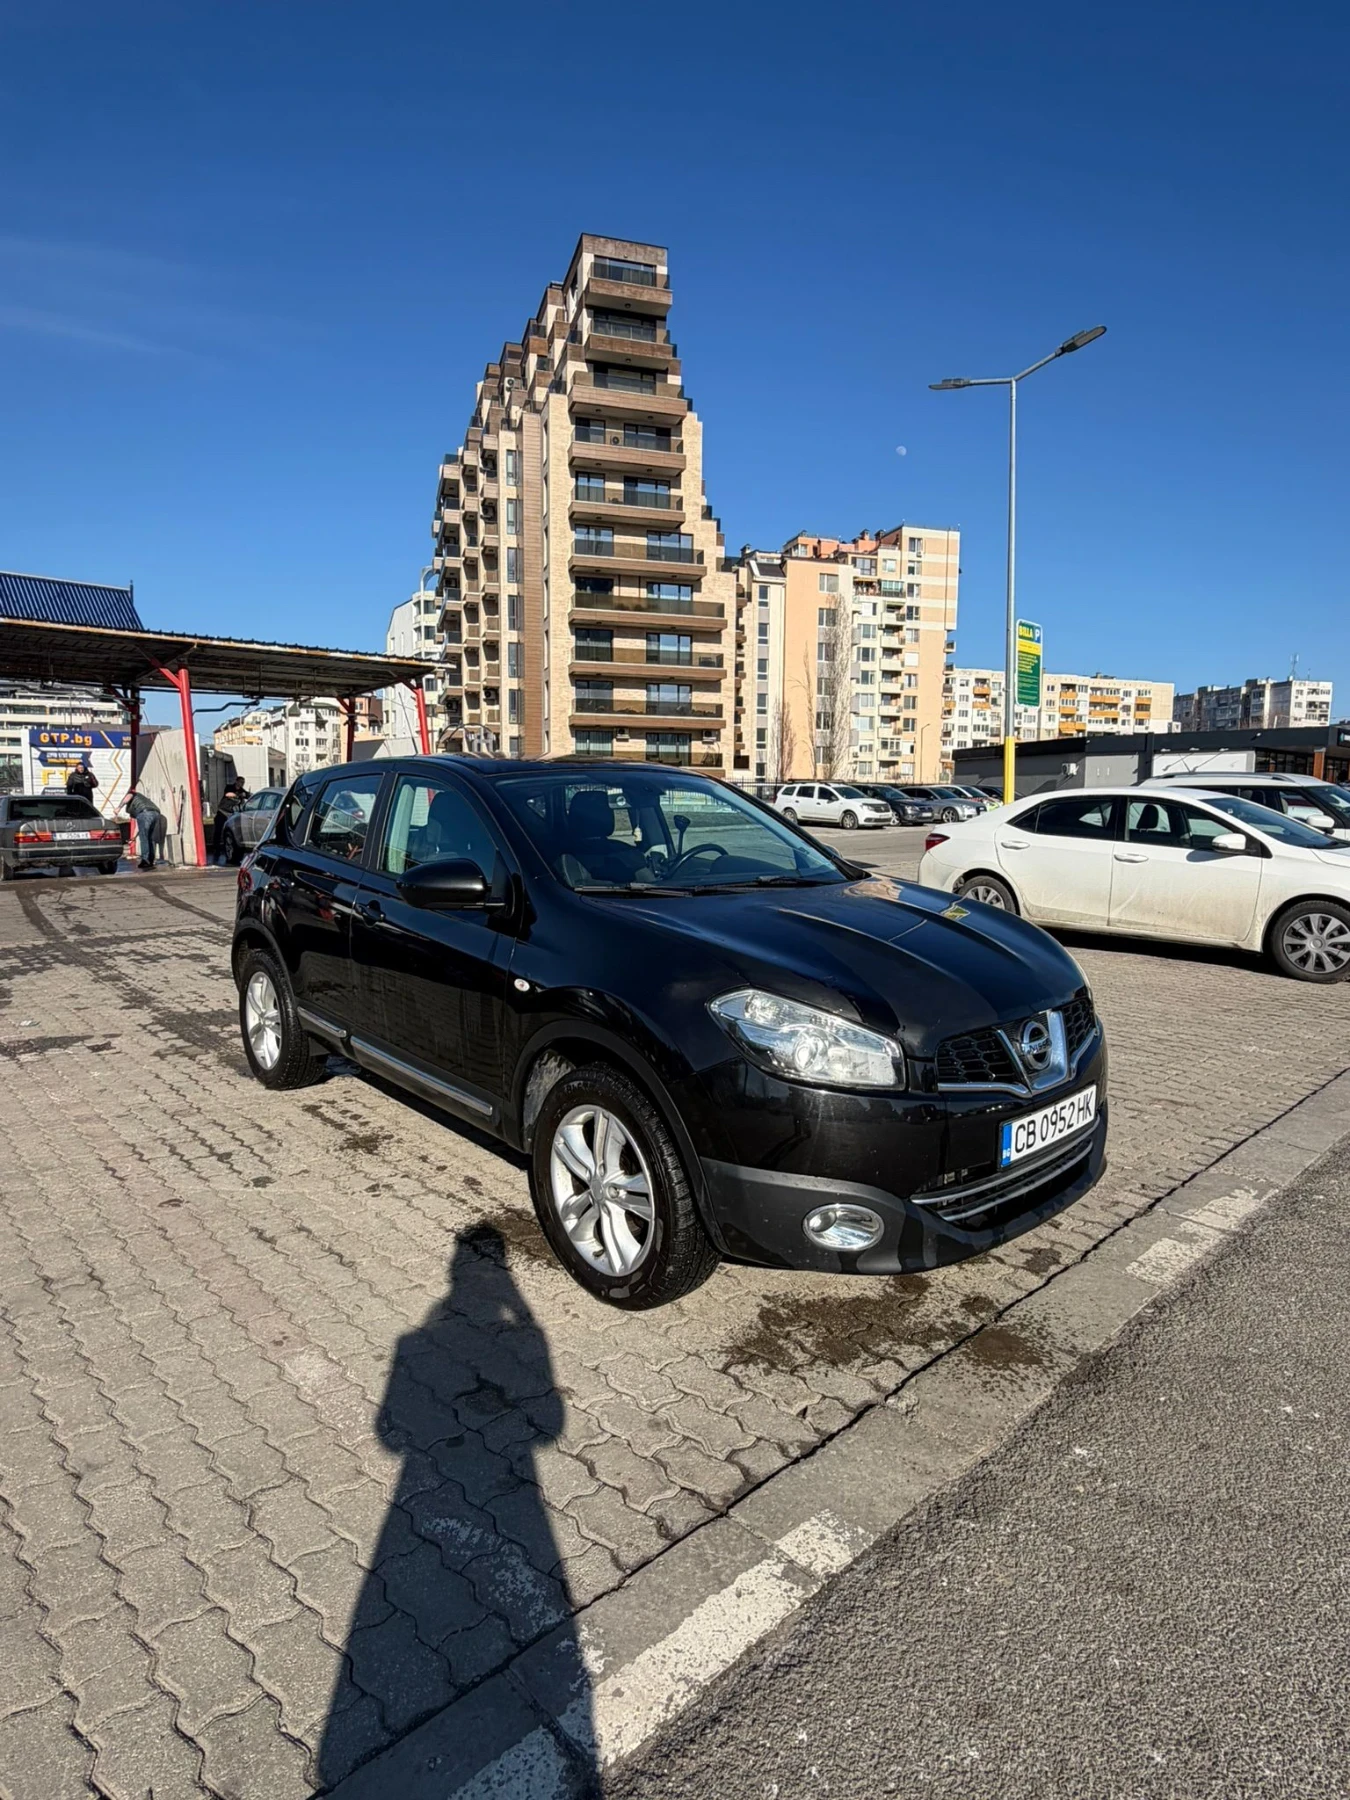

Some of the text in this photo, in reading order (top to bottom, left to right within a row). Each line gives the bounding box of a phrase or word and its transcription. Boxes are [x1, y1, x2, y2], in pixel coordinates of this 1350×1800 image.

[39, 732, 93, 747] GTP.bg
[1014, 1090, 1094, 1154] CB 0952 HK
